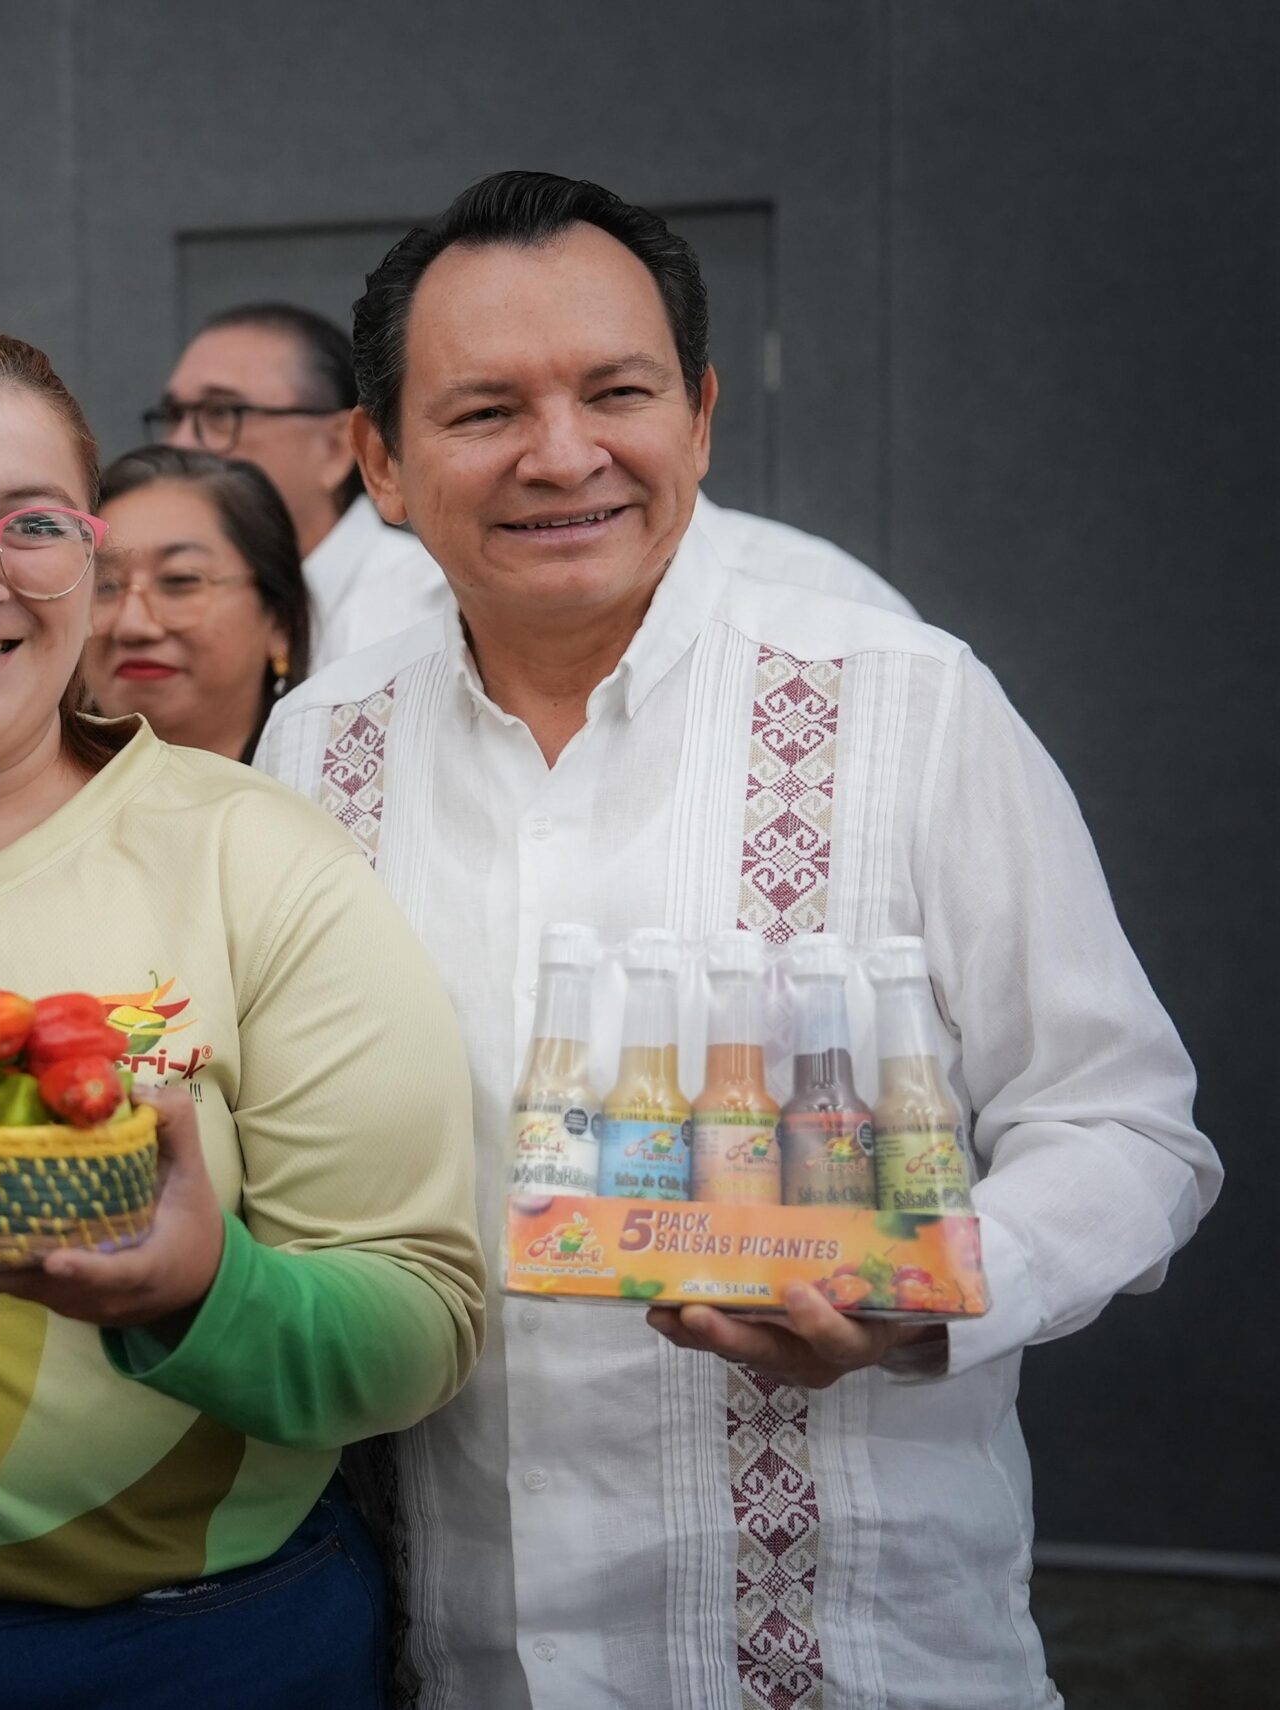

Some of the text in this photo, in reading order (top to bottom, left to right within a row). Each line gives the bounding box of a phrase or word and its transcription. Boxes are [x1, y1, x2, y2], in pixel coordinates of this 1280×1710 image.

[615, 1172, 639, 1187] Salsa
[642, 1174, 655, 1188] de
[619, 1209, 710, 1251] 5 PACK
[655, 1231, 839, 1260] SALSAS PICANTES
